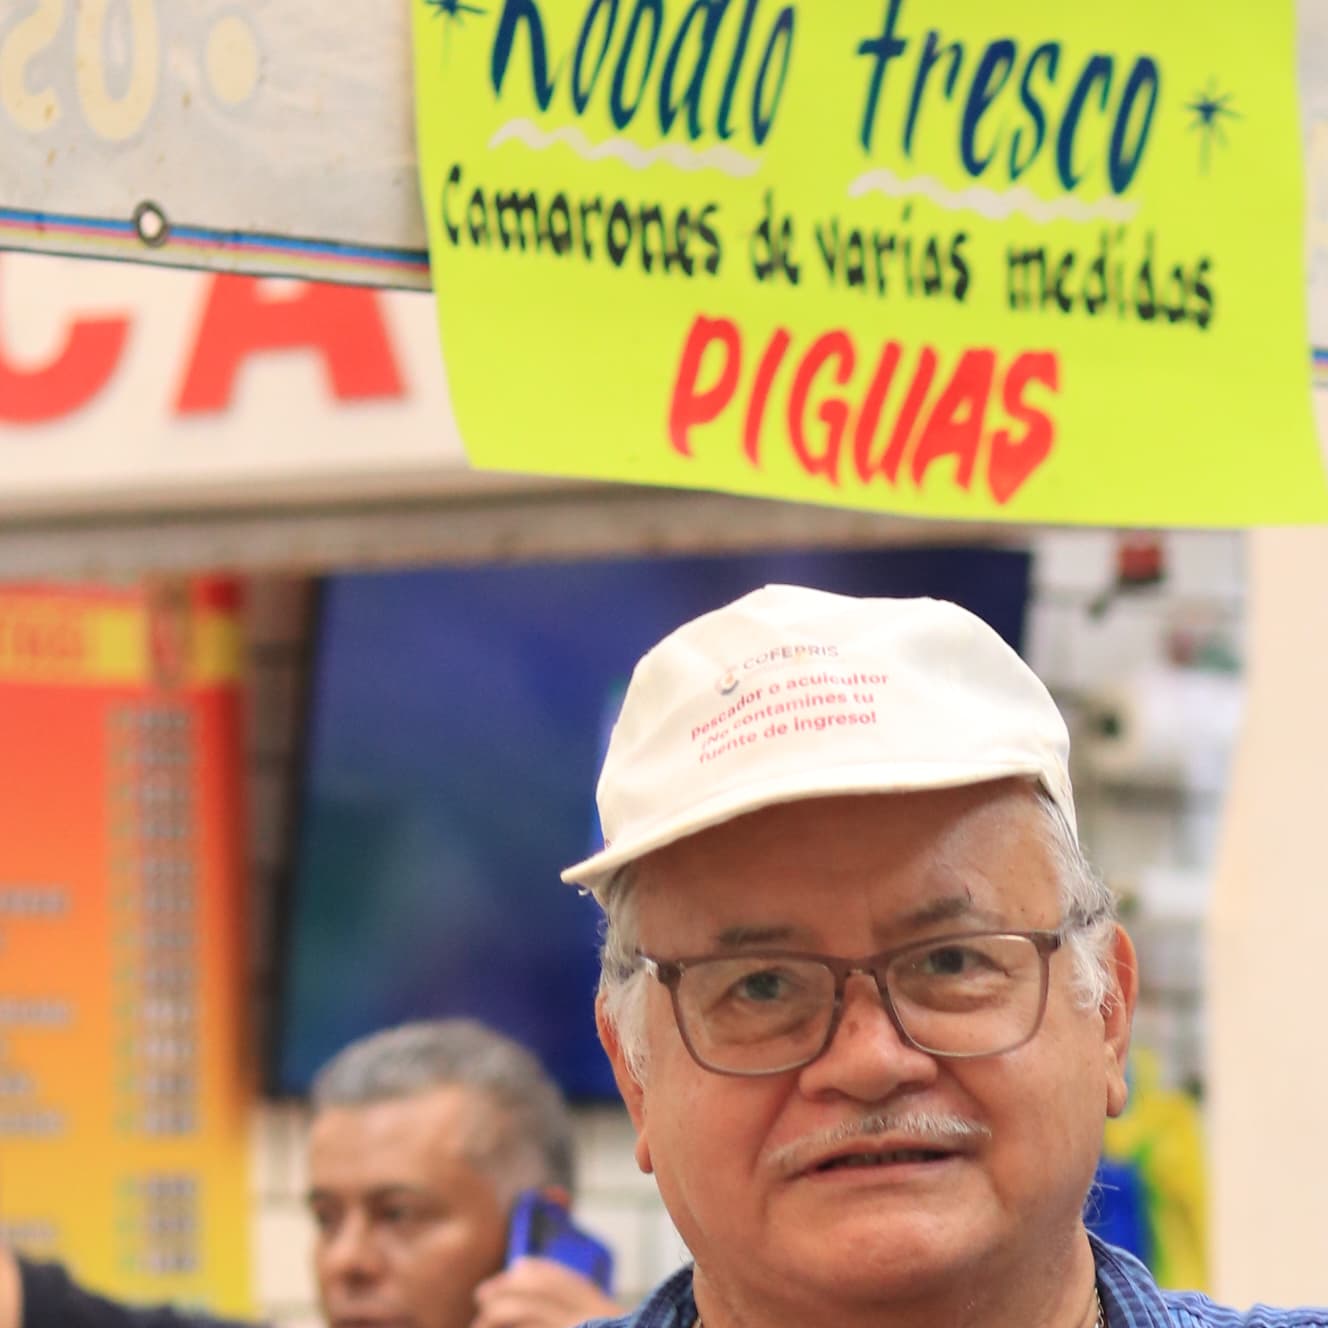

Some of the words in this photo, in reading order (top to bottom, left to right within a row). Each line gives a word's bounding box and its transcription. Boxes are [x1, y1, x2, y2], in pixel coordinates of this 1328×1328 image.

[442, 165, 724, 278] Camarones
[749, 190, 800, 286] de
[815, 206, 972, 304] varias
[1005, 226, 1216, 332] medidas
[667, 313, 1061, 506] PIGUAS
[743, 645, 839, 670] COFEPRIS
[786, 672, 889, 691] acuicultor
[732, 692, 848, 730] contamines
[852, 692, 875, 705] tu
[763, 721, 789, 739] de
